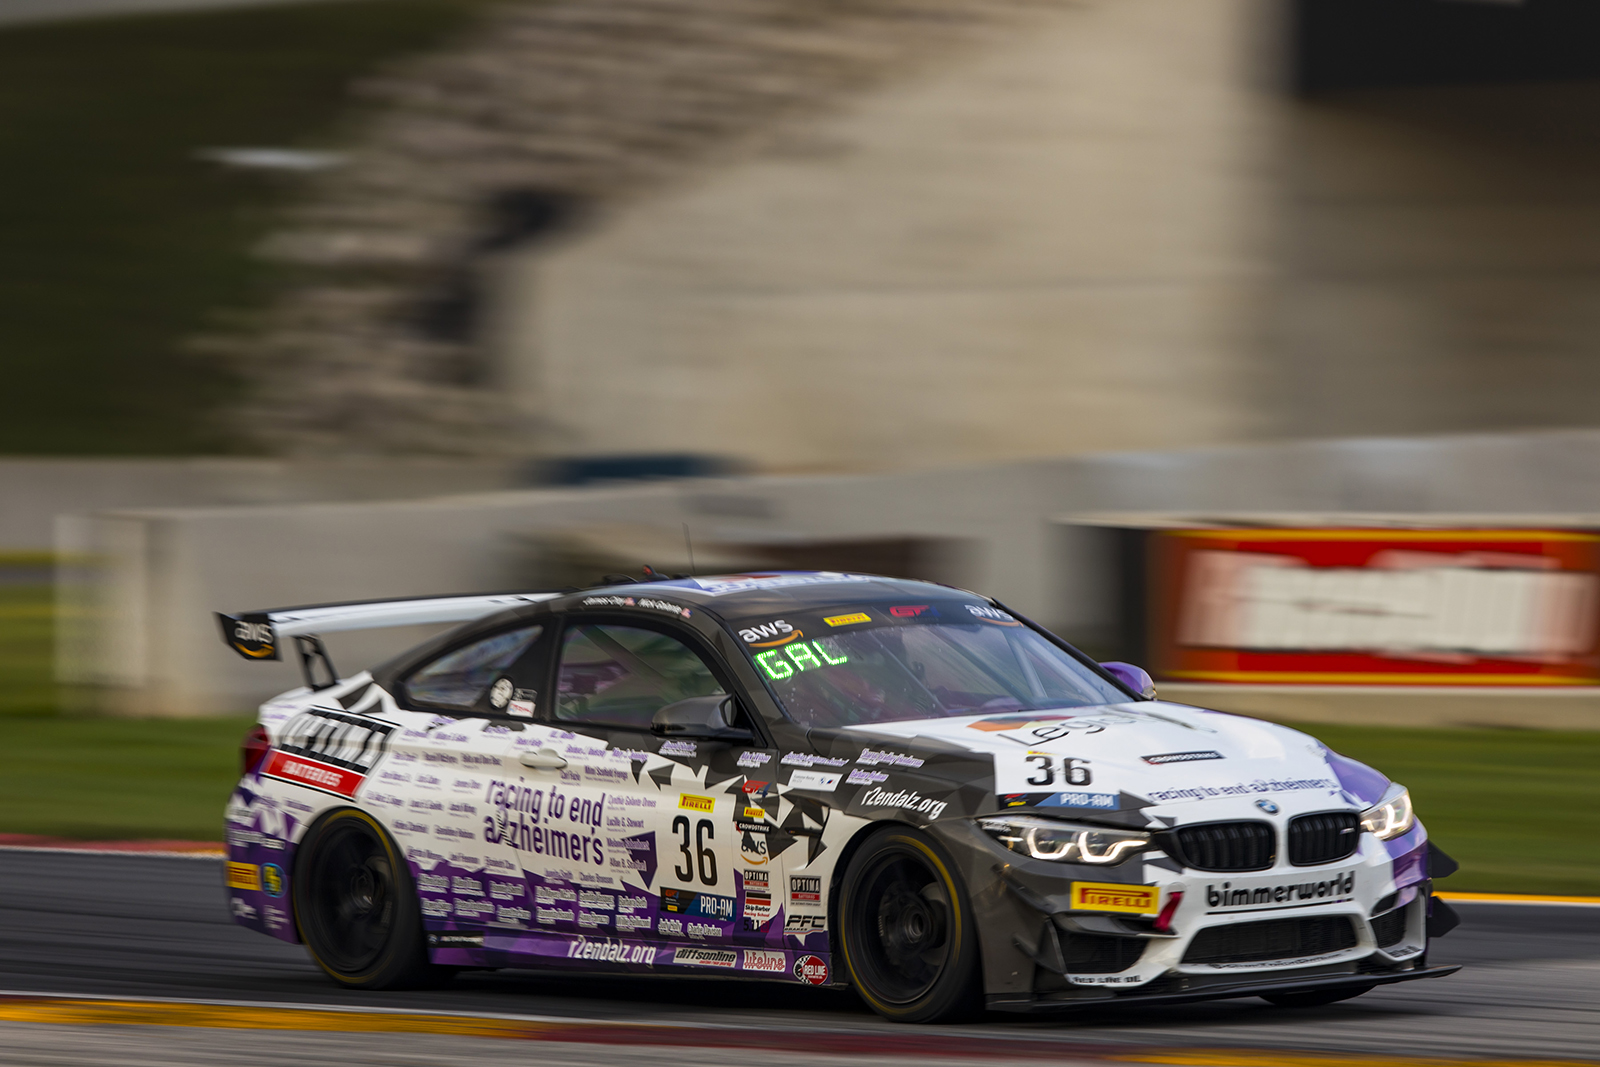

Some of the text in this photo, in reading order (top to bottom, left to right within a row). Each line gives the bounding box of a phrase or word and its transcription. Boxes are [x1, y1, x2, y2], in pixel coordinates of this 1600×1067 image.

[829, 614, 868, 624] PIRELLI
[964, 604, 1014, 621] aws
[234, 620, 273, 644] aws
[738, 619, 793, 642] aws
[756, 640, 848, 680] GAL
[1025, 755, 1092, 786] 36
[485, 776, 544, 824] racing
[548, 785, 566, 819] to
[569, 792, 606, 828] end
[681, 796, 712, 811] PIRELLI
[861, 786, 948, 821] r2endalz.org
[1059, 793, 1114, 808] PRO-AM
[738, 822, 770, 833] CROWDSTRIKE
[672, 814, 718, 887] 36
[744, 870, 768, 882] OPTIMA
[791, 878, 820, 893] OPTIMA
[1080, 887, 1150, 908] PIRELLI
[1205, 870, 1355, 907] bimmerworld
[700, 895, 733, 918] PRO-AM
[786, 915, 827, 928] PFC
[567, 934, 656, 969] r2endalz.org
[675, 949, 736, 962] diffsonline
[743, 950, 785, 971] lifeline
[803, 964, 826, 976] RED LINE
